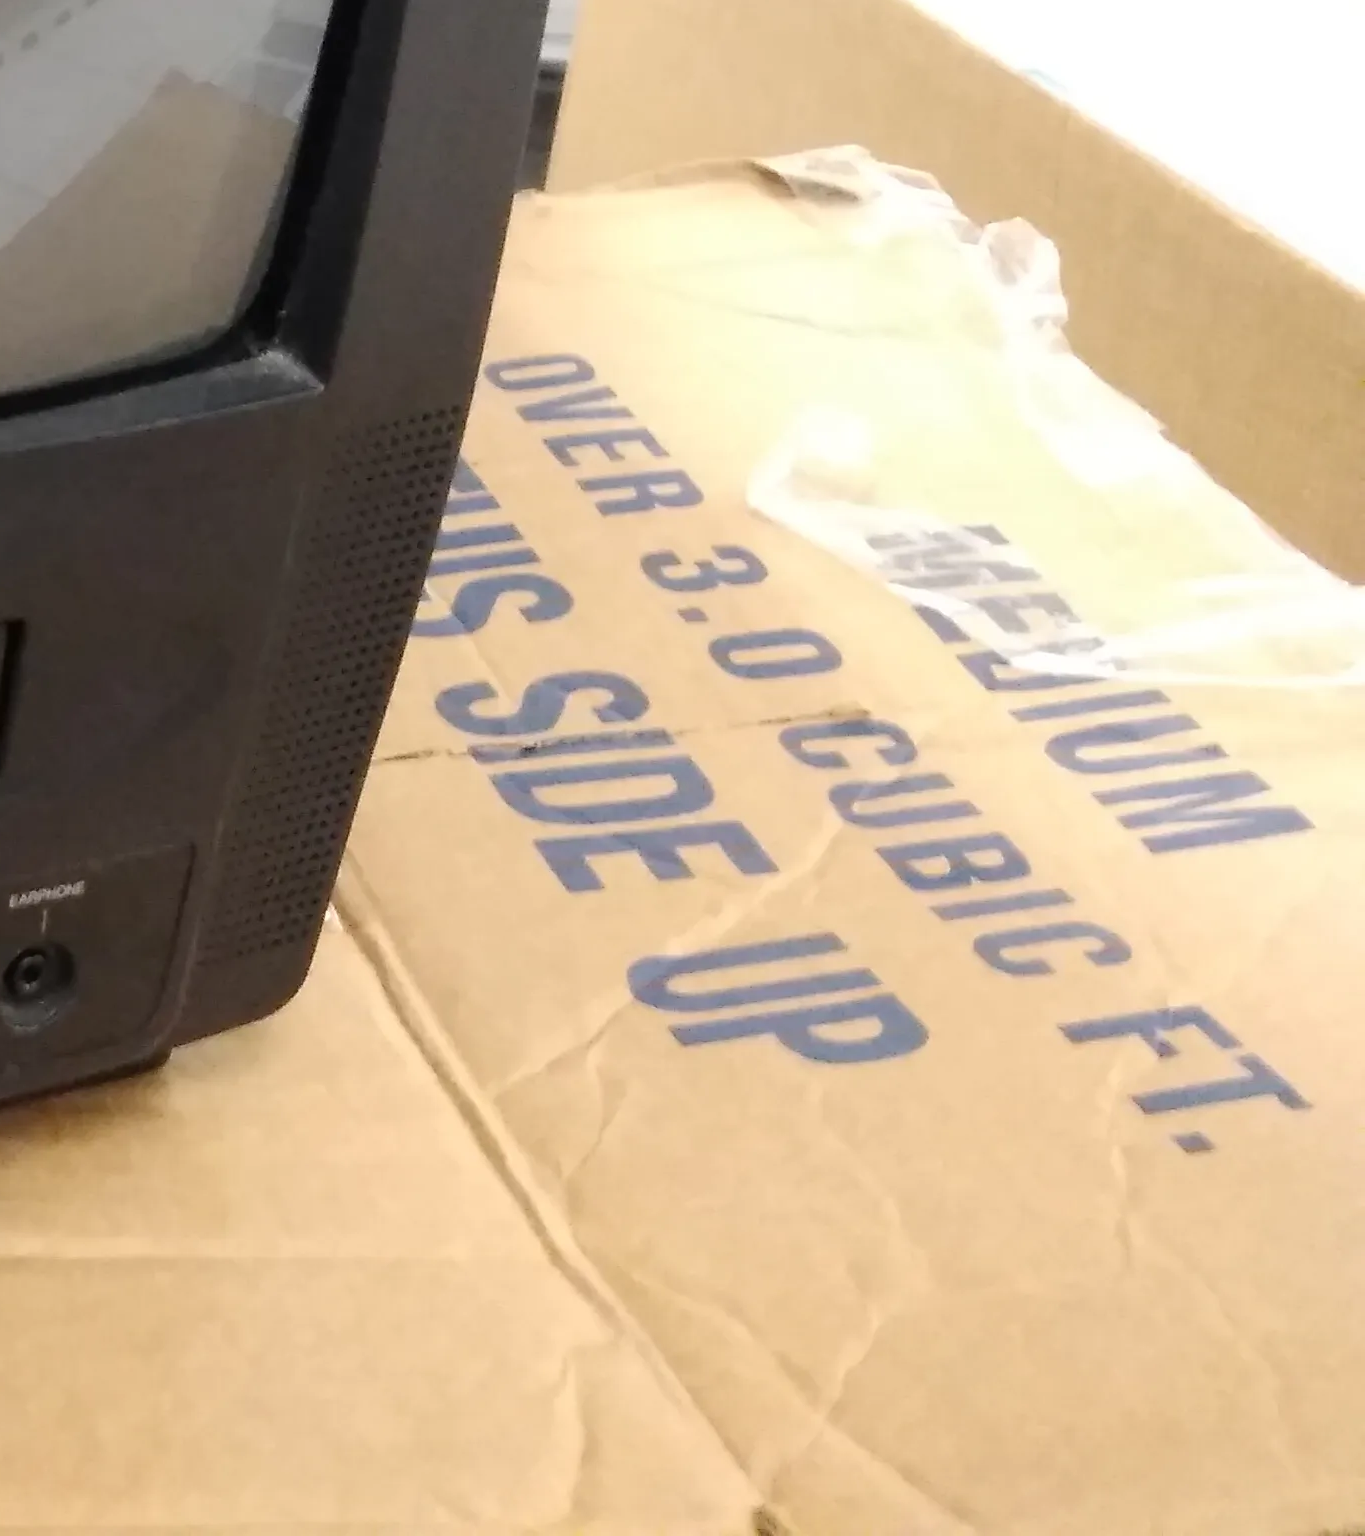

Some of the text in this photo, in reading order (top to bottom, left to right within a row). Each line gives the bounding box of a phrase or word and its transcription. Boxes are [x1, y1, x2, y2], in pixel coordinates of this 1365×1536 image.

[434, 670, 781, 894] SIDE
[626, 931, 931, 1065] UP
[483, 351, 1316, 1154] OVER 3.0 CUBIC FT.
